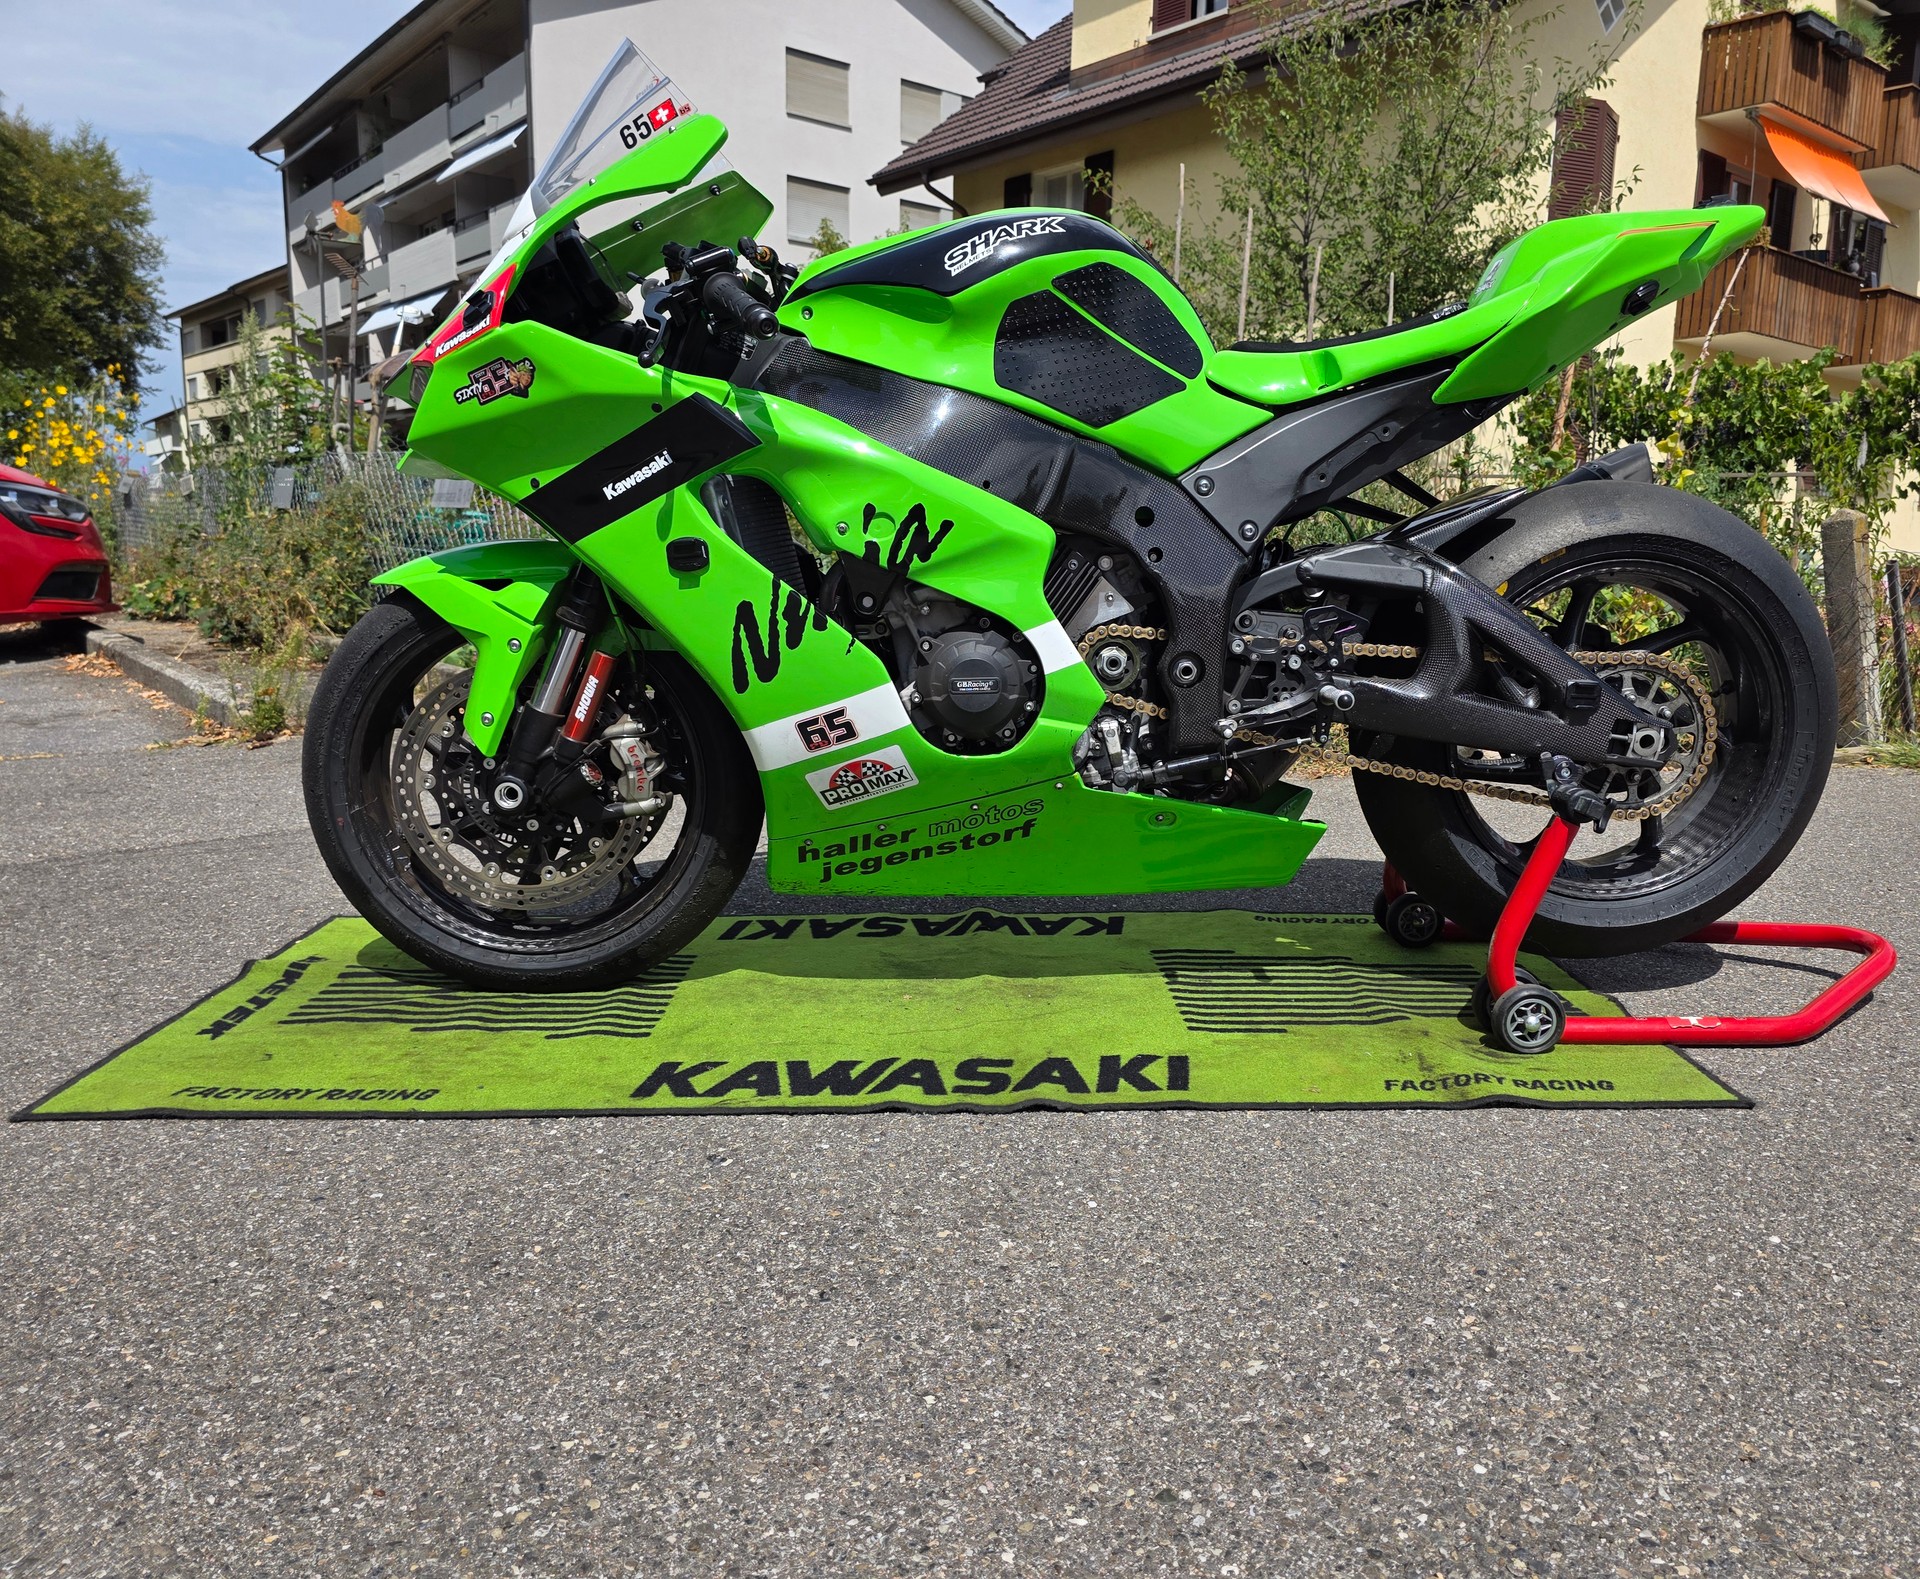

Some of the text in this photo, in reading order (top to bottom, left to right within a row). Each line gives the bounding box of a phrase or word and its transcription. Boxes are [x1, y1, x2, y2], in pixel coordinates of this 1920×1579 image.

[619, 113, 652, 150] 65
[944, 216, 1066, 271] SHARK
[953, 248, 992, 273] HELMETS
[435, 314, 490, 358] Kawasaki
[455, 381, 483, 402] SIXTY
[602, 450, 673, 501] Kawasaki
[575, 674, 599, 723] SHOWA
[796, 706, 859, 752] 65
[627, 744, 648, 792] brembo
[824, 769, 909, 802] PRO MAX
[798, 798, 1044, 863] haller motos
[820, 818, 1037, 883] jegenstorf
[717, 911, 1125, 940] KAWASAKI
[1254, 915, 1327, 924] RACING
[171, 1086, 441, 1101] FACTORY RACING
[630, 1054, 1190, 1098] KAWASAKI
[1383, 1072, 1615, 1092] FACTORY RACING
